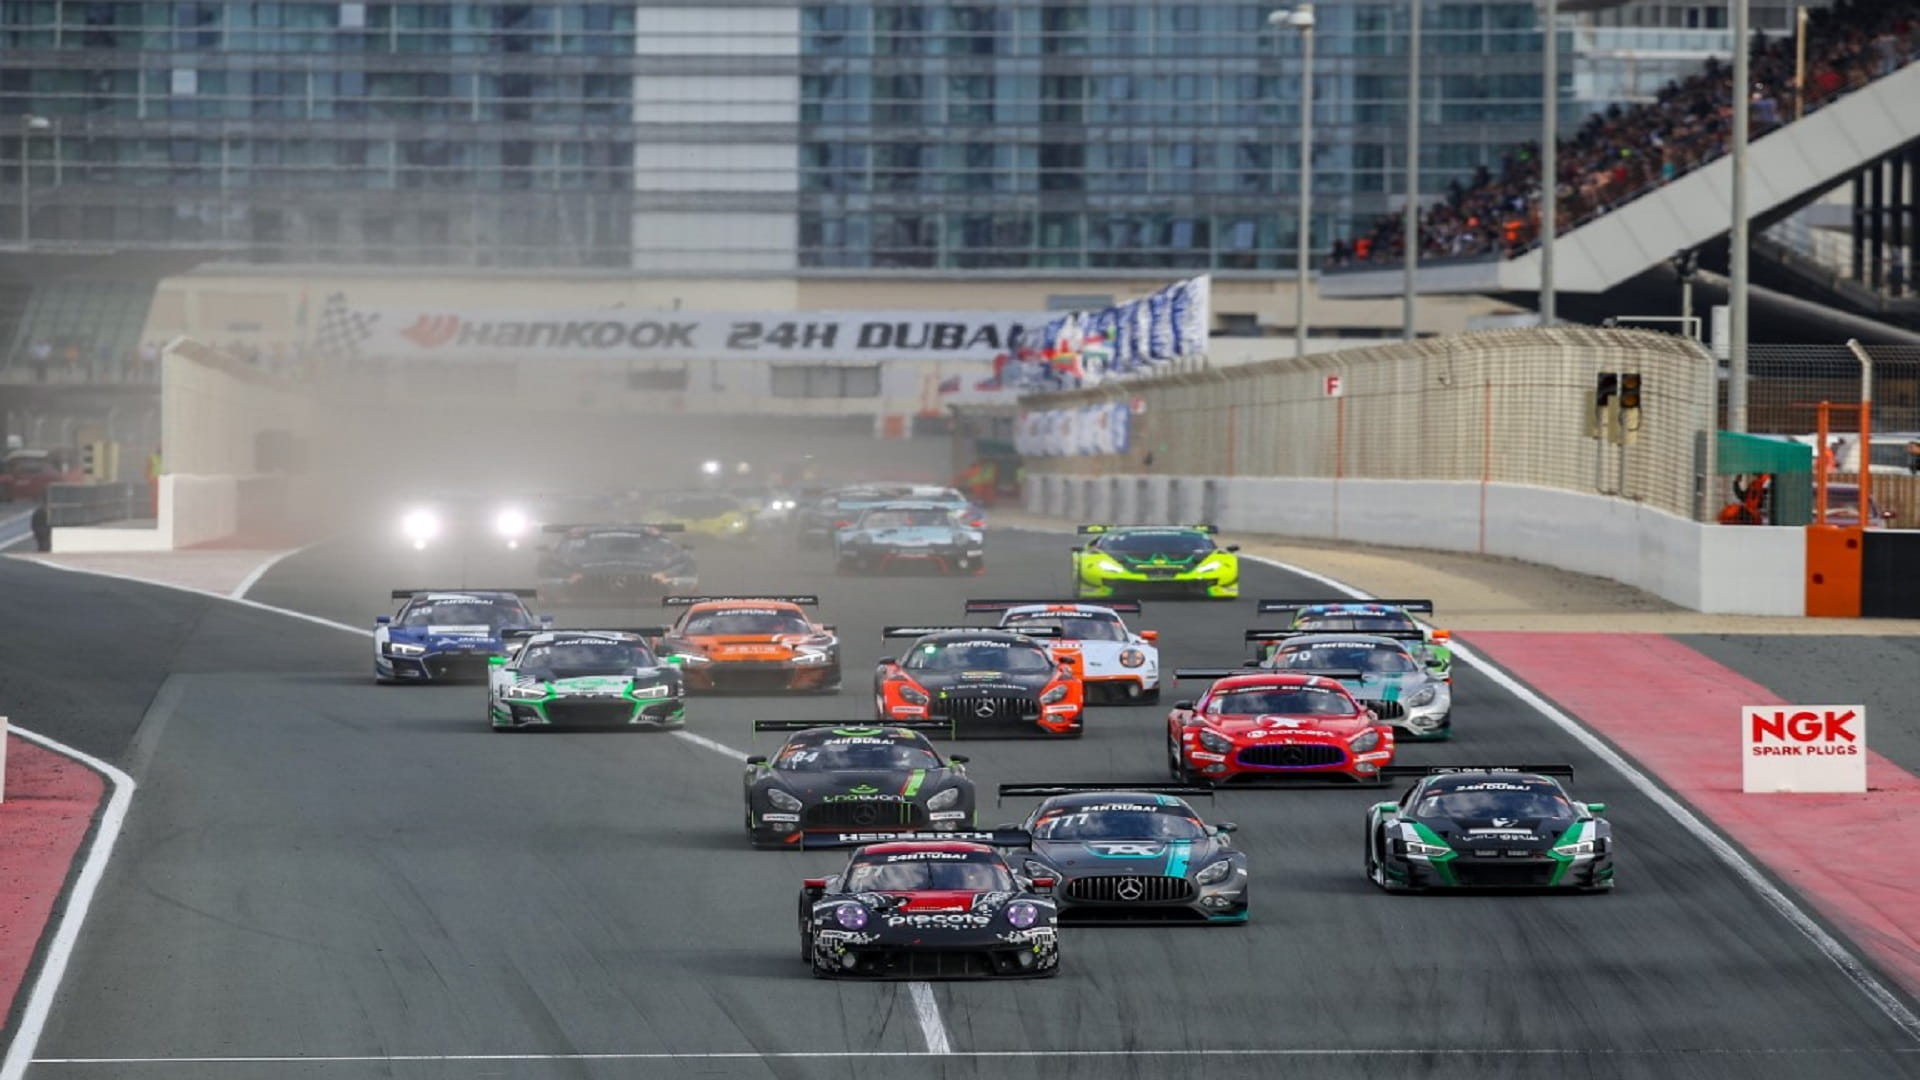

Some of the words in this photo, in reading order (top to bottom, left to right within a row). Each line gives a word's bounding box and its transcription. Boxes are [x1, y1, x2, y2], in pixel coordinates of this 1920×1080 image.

[727, 321, 840, 350] 24H
[1327, 376, 1339, 396] F
[1287, 650, 1311, 663] 70
[1752, 710, 1856, 742] NGK
[851, 736, 895, 745] DUBAI
[1753, 746, 1802, 756] SPARK
[1806, 745, 1858, 755] PLUGS
[1486, 783, 1531, 791] DUBAI
[1111, 803, 1158, 812] DUBAI
[1047, 813, 1089, 832] 777
[839, 832, 994, 841] HERBERTH
[887, 853, 917, 862] 24H
[888, 913, 991, 927] precote
